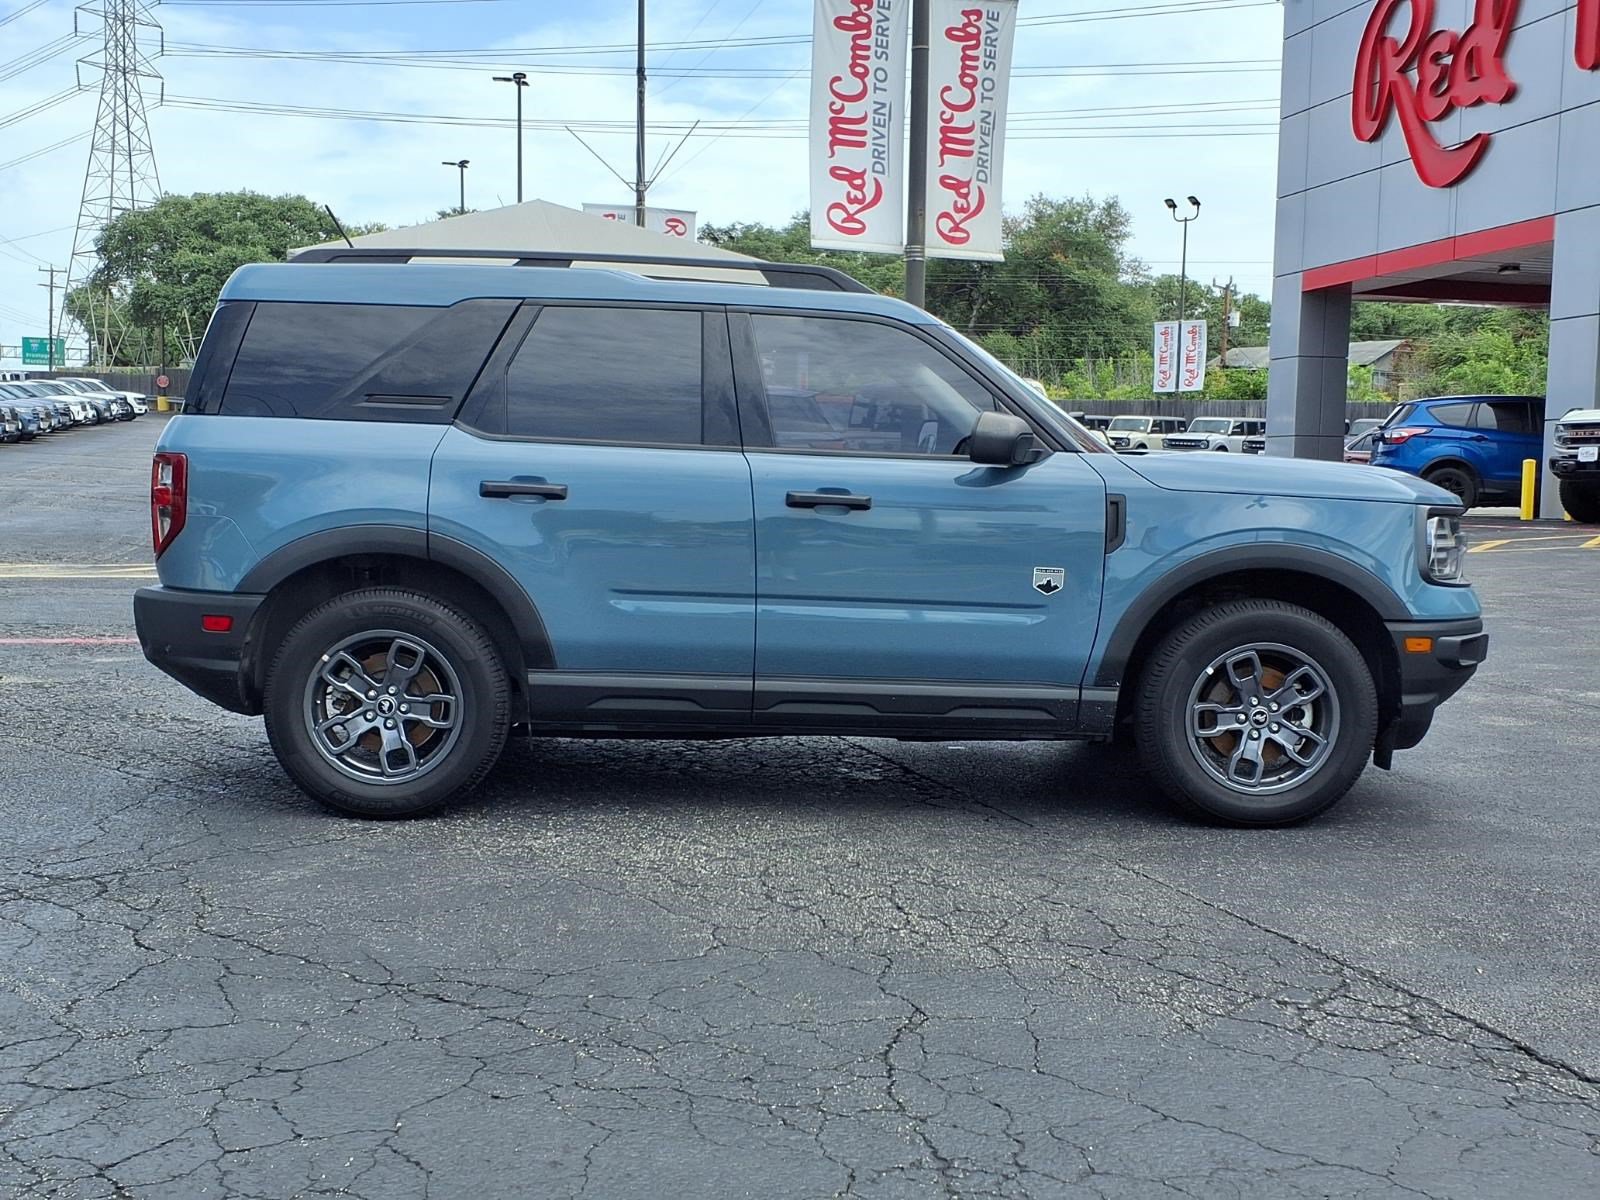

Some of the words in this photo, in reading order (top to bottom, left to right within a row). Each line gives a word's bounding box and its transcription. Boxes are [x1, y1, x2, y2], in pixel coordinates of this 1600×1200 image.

[874, 0, 892, 62] SERVE
[984, 9, 1000, 71] SERVE
[873, 69, 889, 94] TO
[981, 78, 996, 103] TO
[1352, 0, 1518, 188] Red
[872, 101, 887, 176] DRIVEN
[976, 110, 992, 184] DRIVEN
[826, 166, 883, 236] Red
[936, 175, 985, 245] Red
